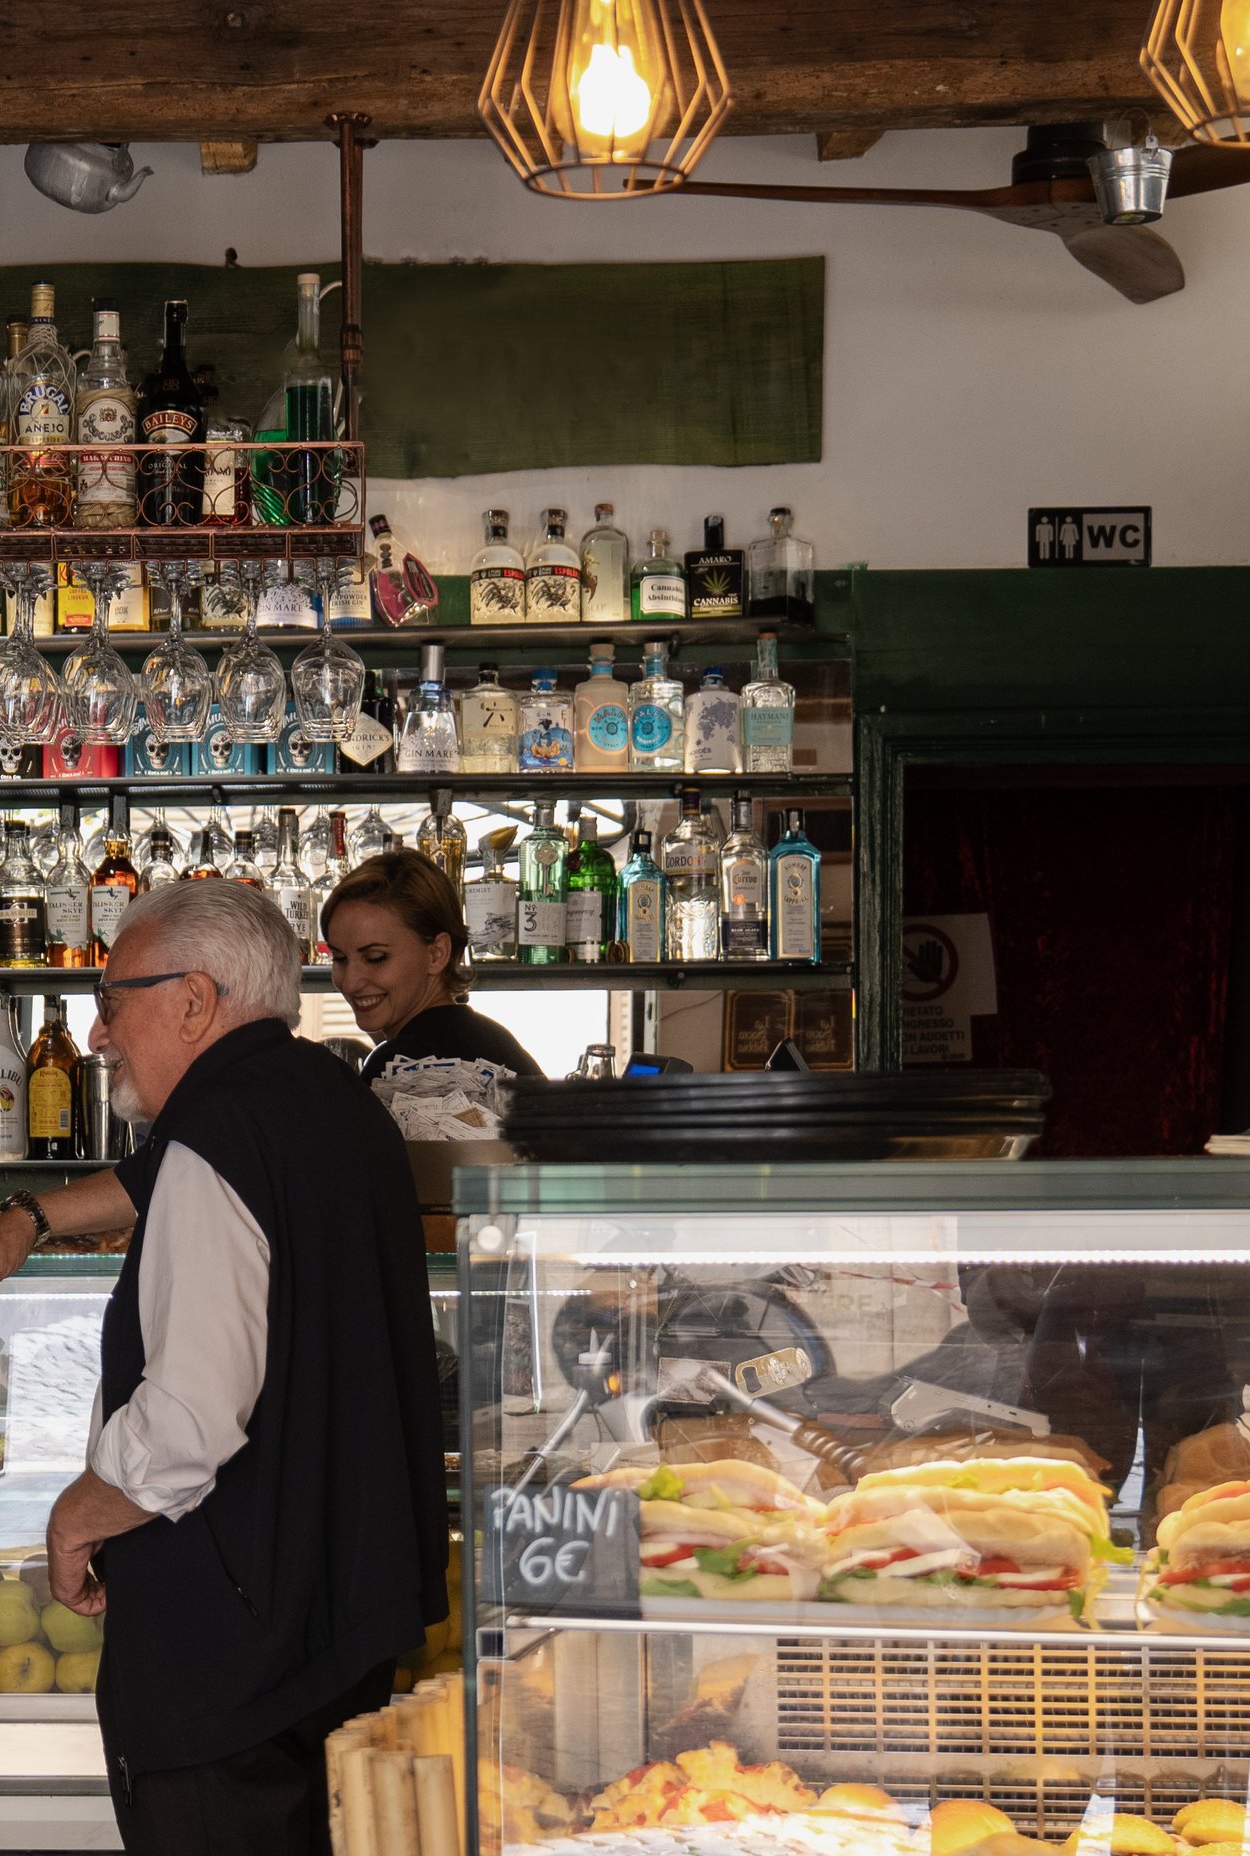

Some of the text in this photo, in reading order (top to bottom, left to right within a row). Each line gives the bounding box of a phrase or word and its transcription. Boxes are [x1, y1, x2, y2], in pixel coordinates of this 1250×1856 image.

[20, 384, 68, 416] BRUGAL
[25, 420, 64, 434] AÑEJO
[145, 414, 192, 430] BAILEYS
[1086, 524, 1140, 548] WC
[699, 556, 732, 565] AMARO
[274, 604, 304, 612] MARE
[694, 596, 738, 606] CANNABIS
[350, 732, 390, 742] NDRICK'S
[428, 750, 454, 758] MARE
[291, 901, 307, 910] WILD
[524, 912, 537, 932] 3
[491, 1486, 622, 1538] PANINI
[519, 1537, 590, 1585] 6€
